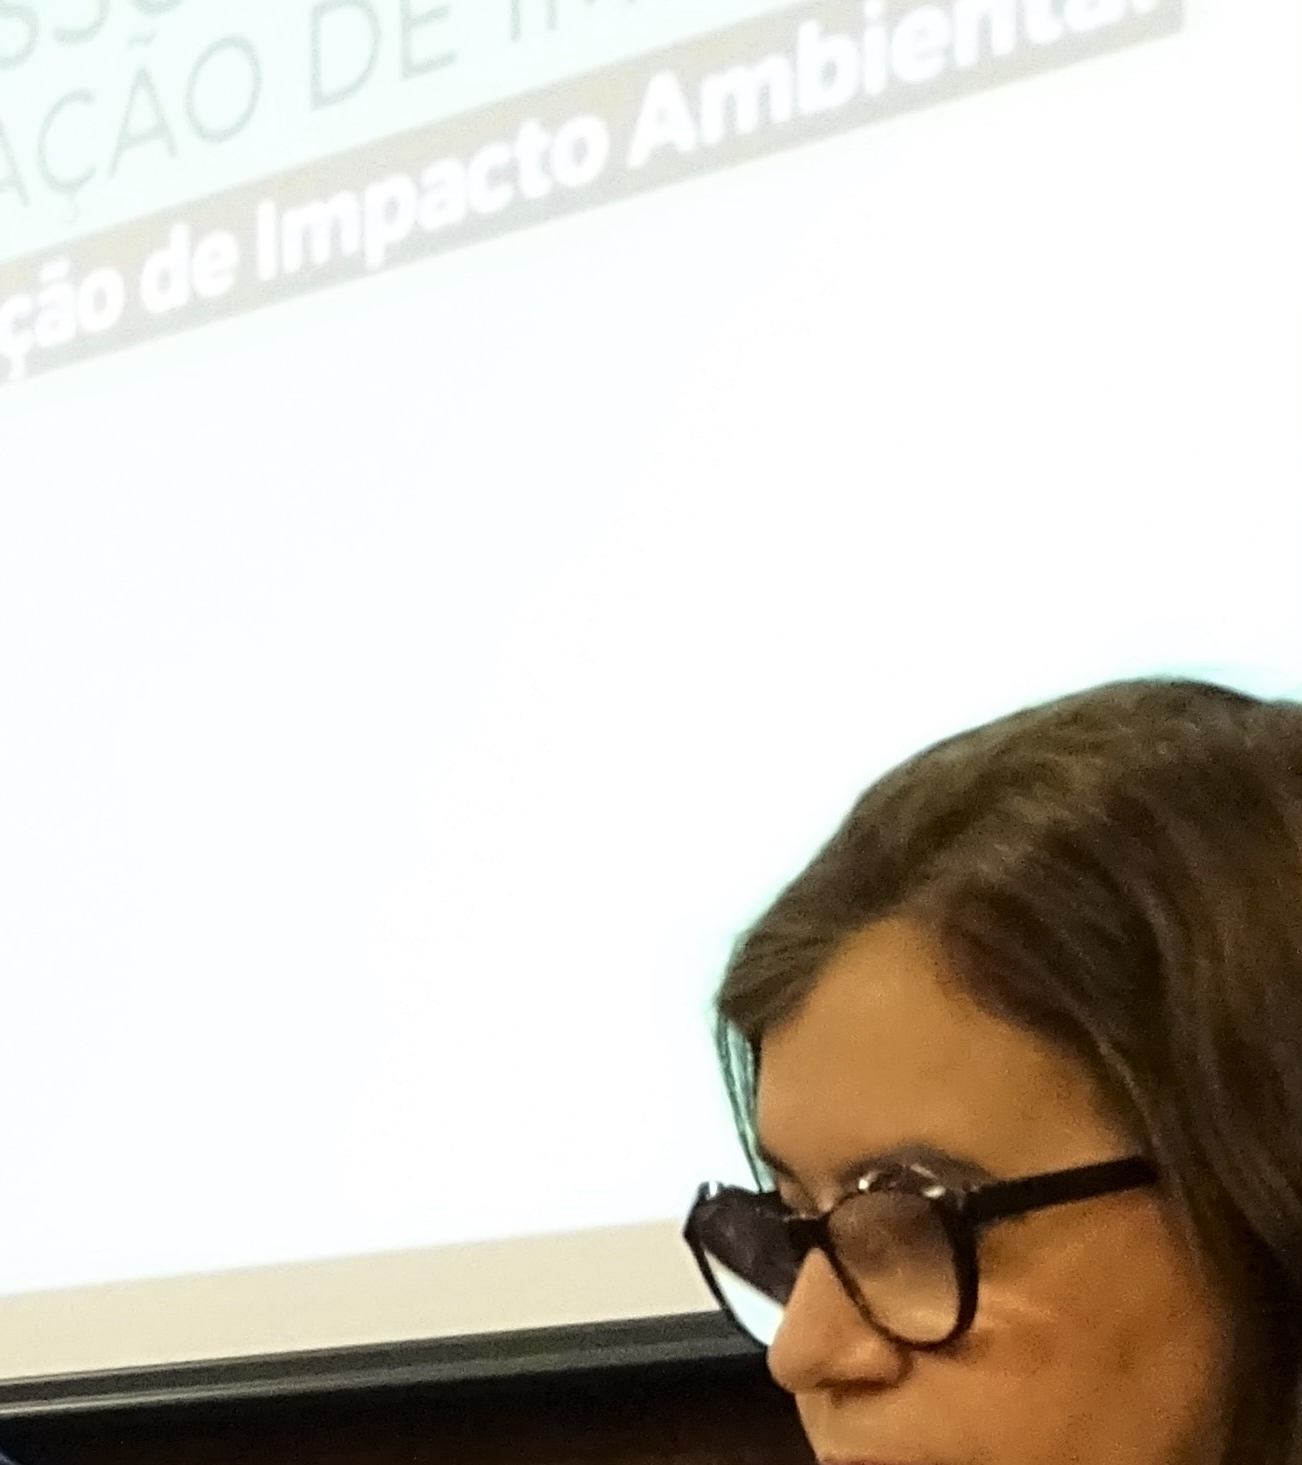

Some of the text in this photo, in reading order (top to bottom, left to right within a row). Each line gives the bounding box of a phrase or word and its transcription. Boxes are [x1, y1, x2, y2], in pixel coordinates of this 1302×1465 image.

[139, 222, 240, 314] de
[255, 114, 611, 283] Impacto
[626, 0, 1153, 169] Ambien
[309, 0, 458, 111] DE
